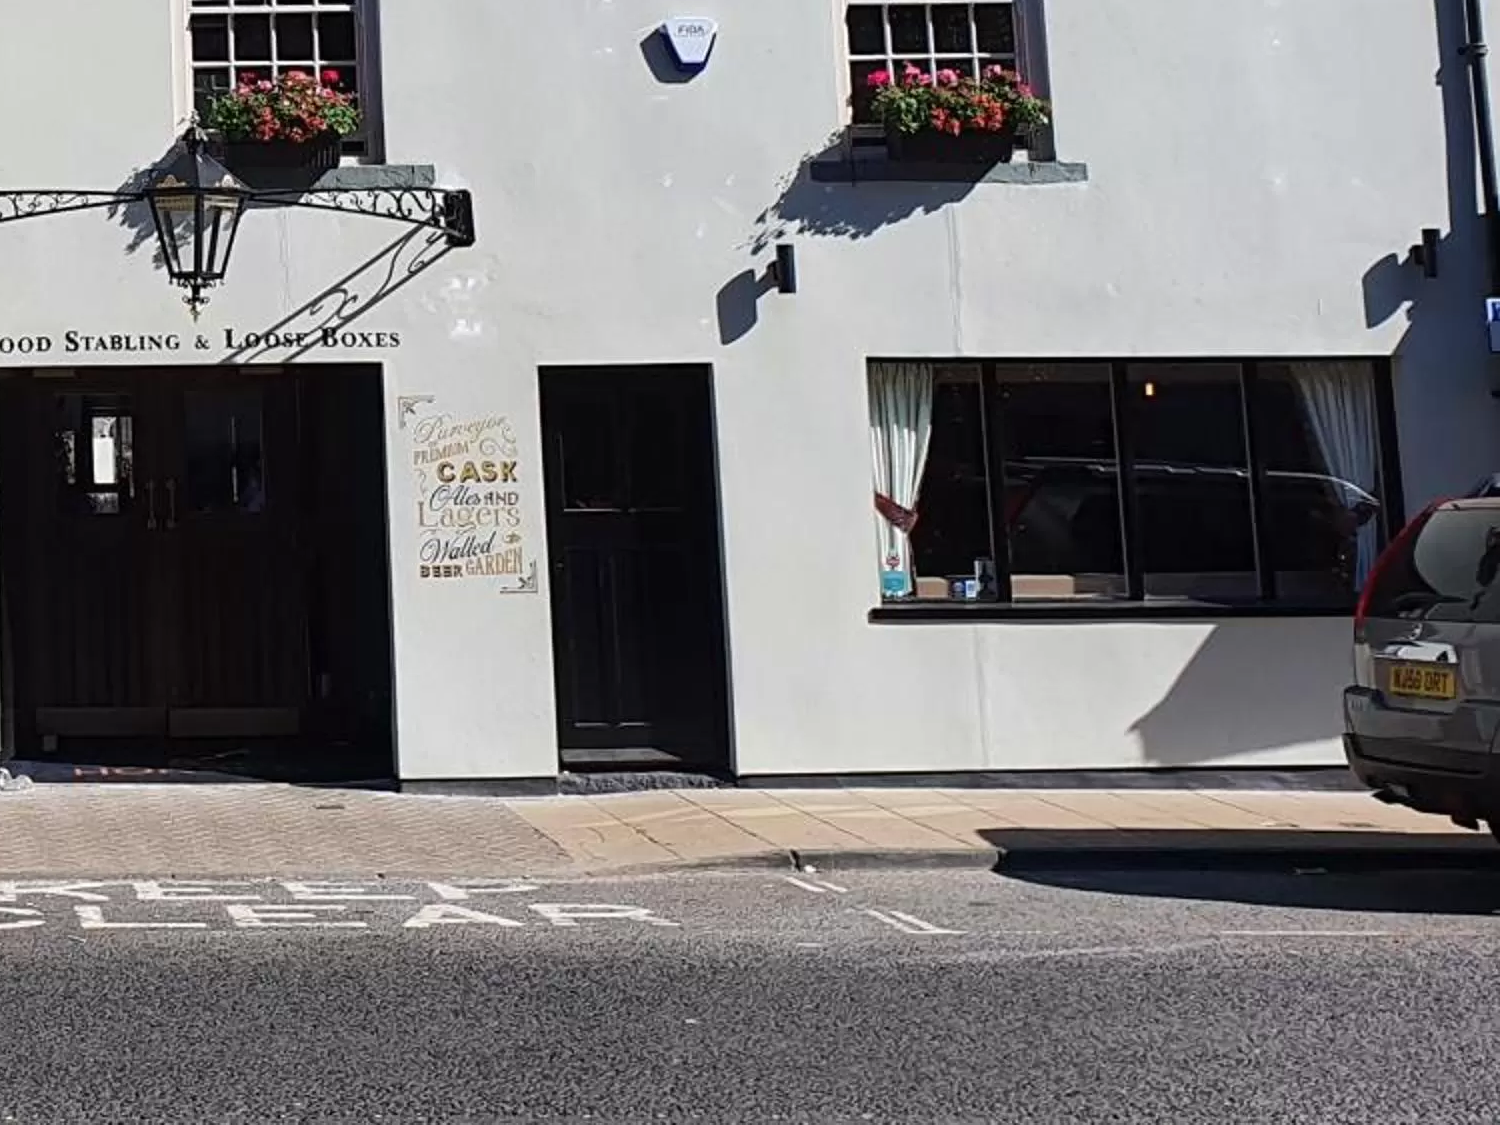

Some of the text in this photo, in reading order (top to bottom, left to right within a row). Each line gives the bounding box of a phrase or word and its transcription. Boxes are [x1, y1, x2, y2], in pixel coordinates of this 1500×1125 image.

[64, 330, 181, 352] STABLING
[194, 335, 210, 350] &
[223, 327, 308, 350] LOOSE
[320, 327, 401, 350] BOXES
[413, 441, 469, 465] PREMIUM
[436, 460, 518, 483] CASK
[429, 484, 519, 511] Ales AND
[418, 500, 521, 530] Lagers
[420, 531, 497, 563] Walled
[419, 547, 523, 578] BEER GARDEN
